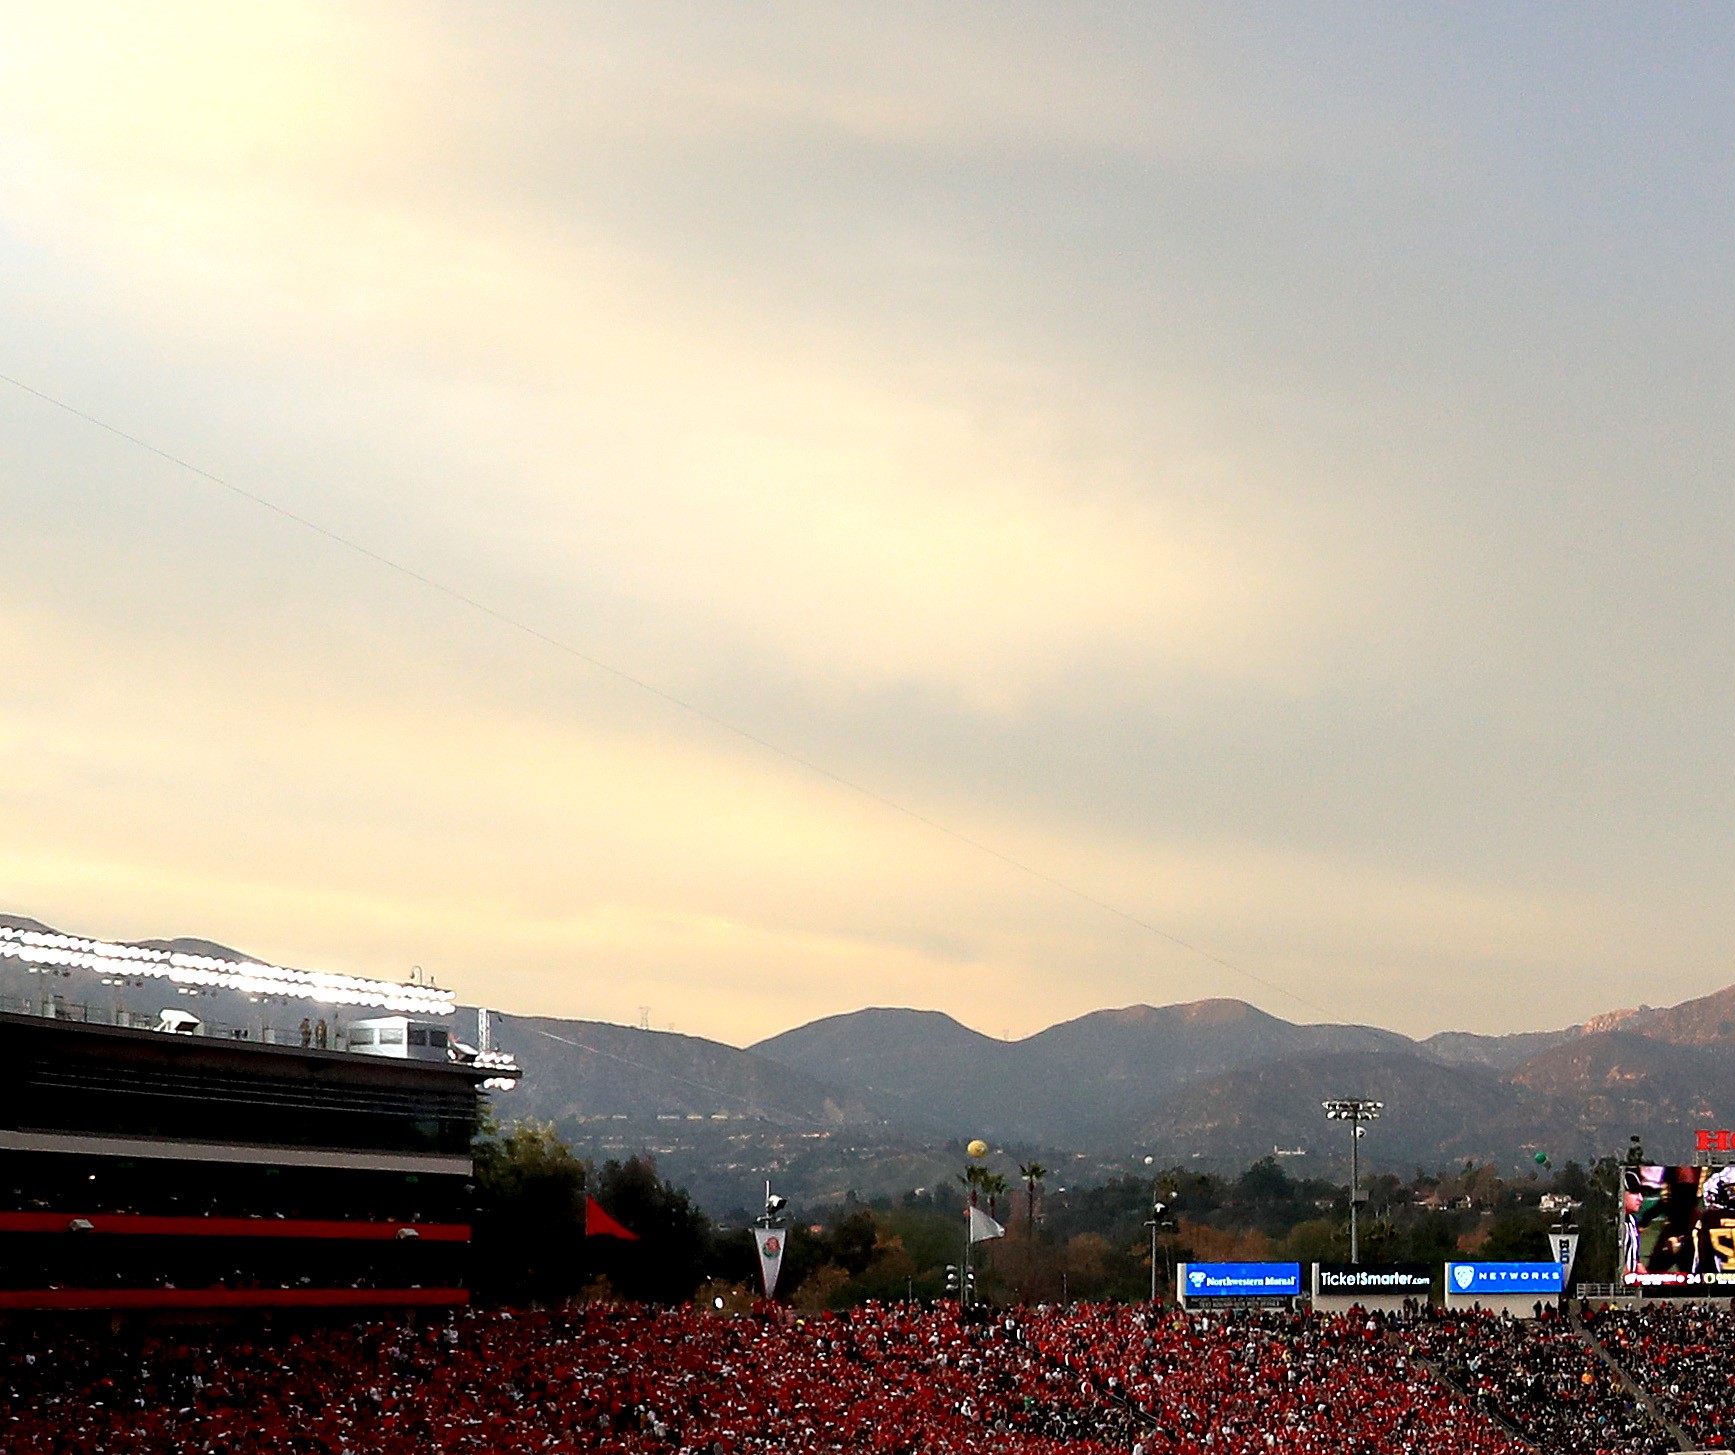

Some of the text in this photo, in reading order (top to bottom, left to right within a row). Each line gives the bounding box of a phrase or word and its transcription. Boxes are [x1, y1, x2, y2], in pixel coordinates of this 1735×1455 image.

[1321, 1272, 1430, 1287] TicketSmarter.com
[1479, 1271, 1560, 1280] NETWORKS
[1206, 1276, 1264, 1286] Northwestern
